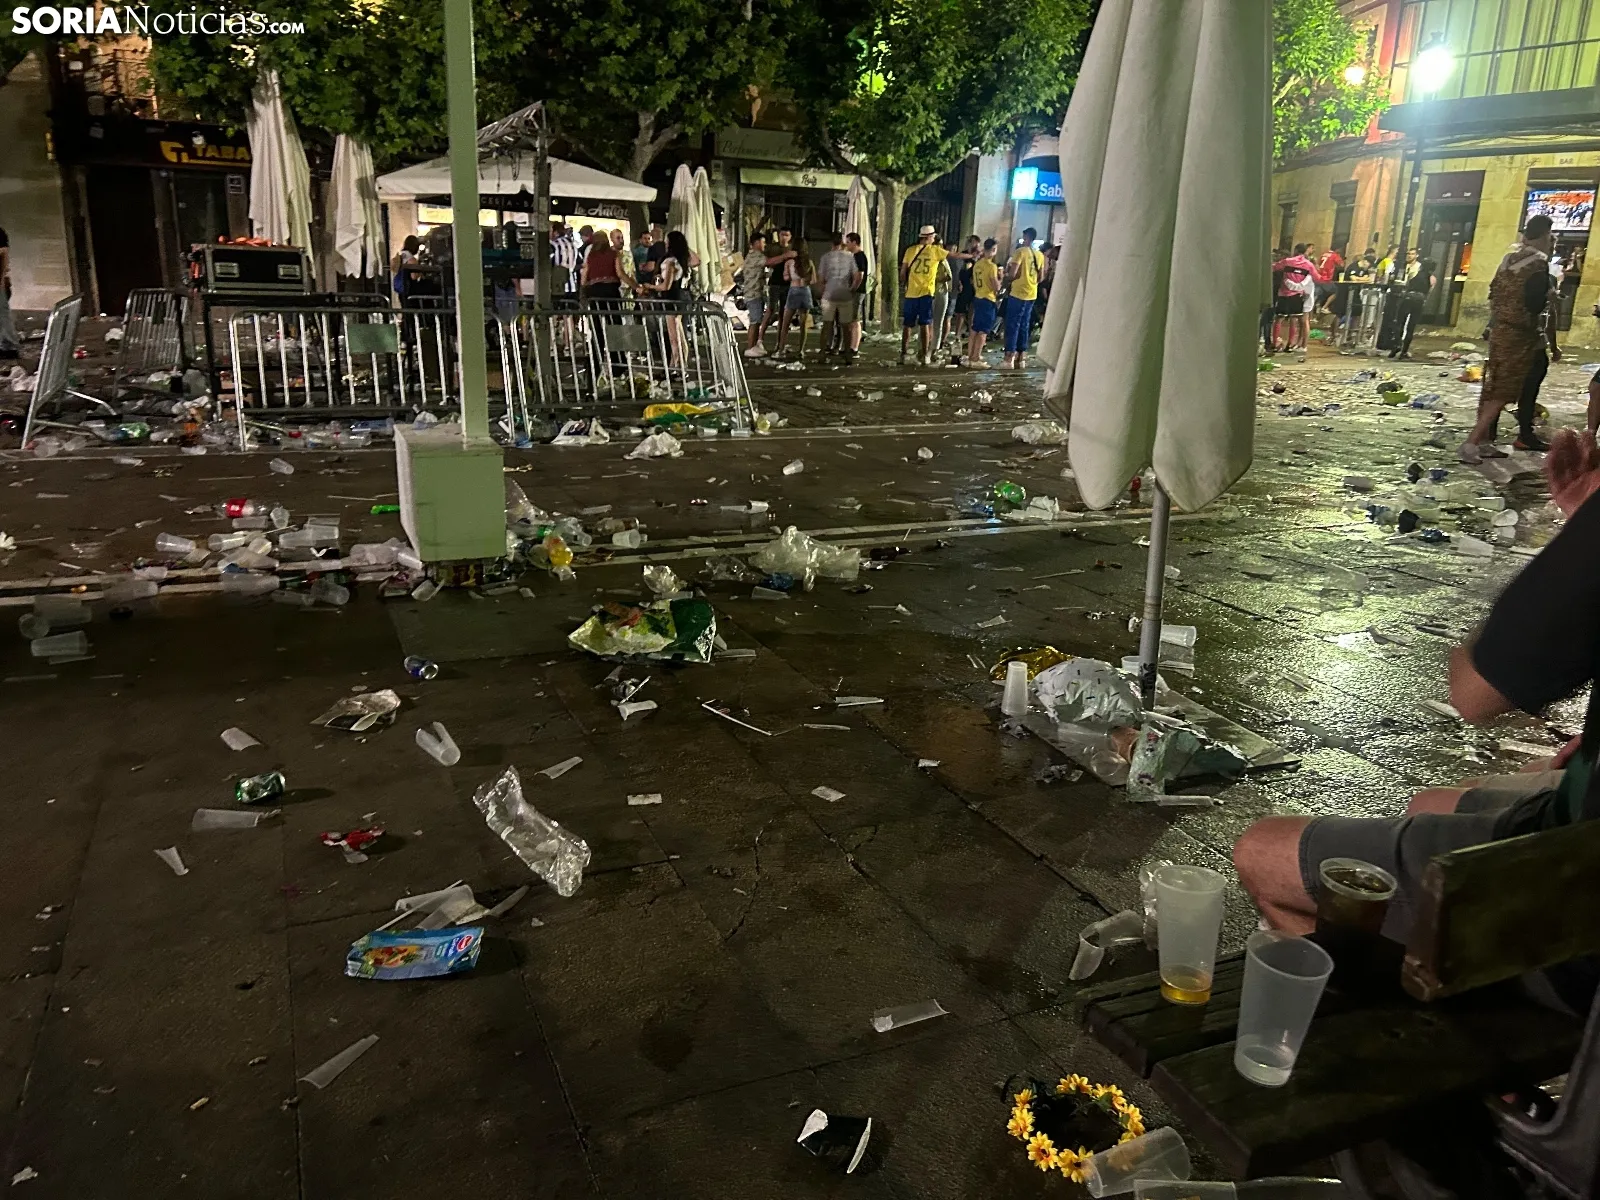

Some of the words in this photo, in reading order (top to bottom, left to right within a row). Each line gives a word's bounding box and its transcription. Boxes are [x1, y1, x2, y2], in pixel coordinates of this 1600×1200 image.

[193, 144, 251, 160] TABA
[1039, 183, 1064, 198] Sab
[914, 258, 931, 275] 25
